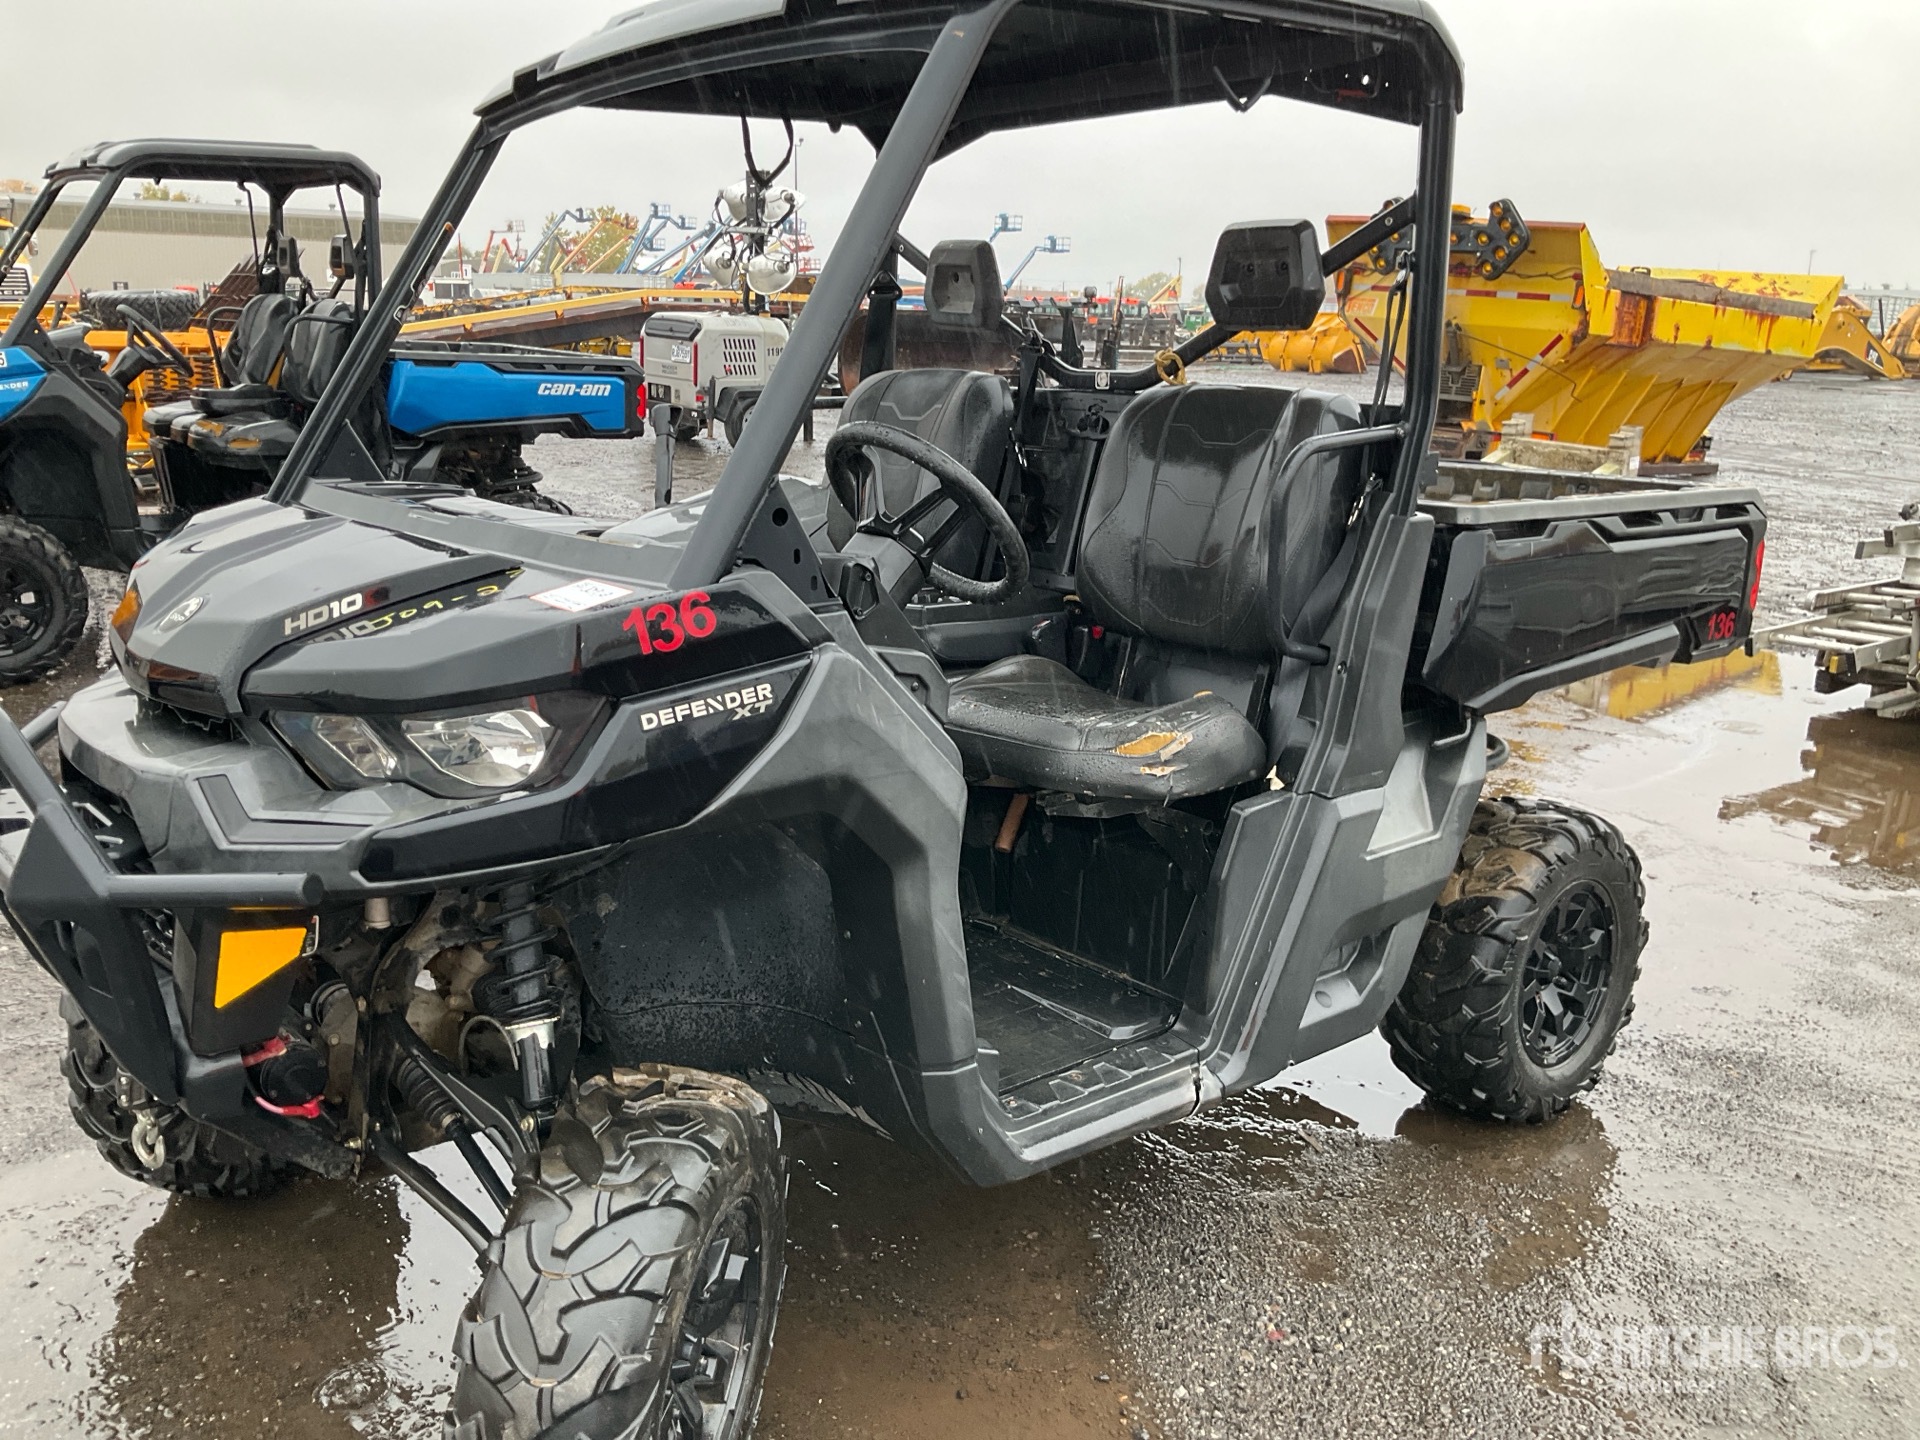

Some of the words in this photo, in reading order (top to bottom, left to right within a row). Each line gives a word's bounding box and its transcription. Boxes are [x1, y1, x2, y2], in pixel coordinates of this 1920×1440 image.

[537, 383, 611, 396] can-am
[284, 593, 362, 636] HD10
[622, 589, 717, 655] 136
[1707, 611, 1736, 641] 136
[640, 683, 773, 731] DEFENDER
[732, 699, 773, 721] XT
